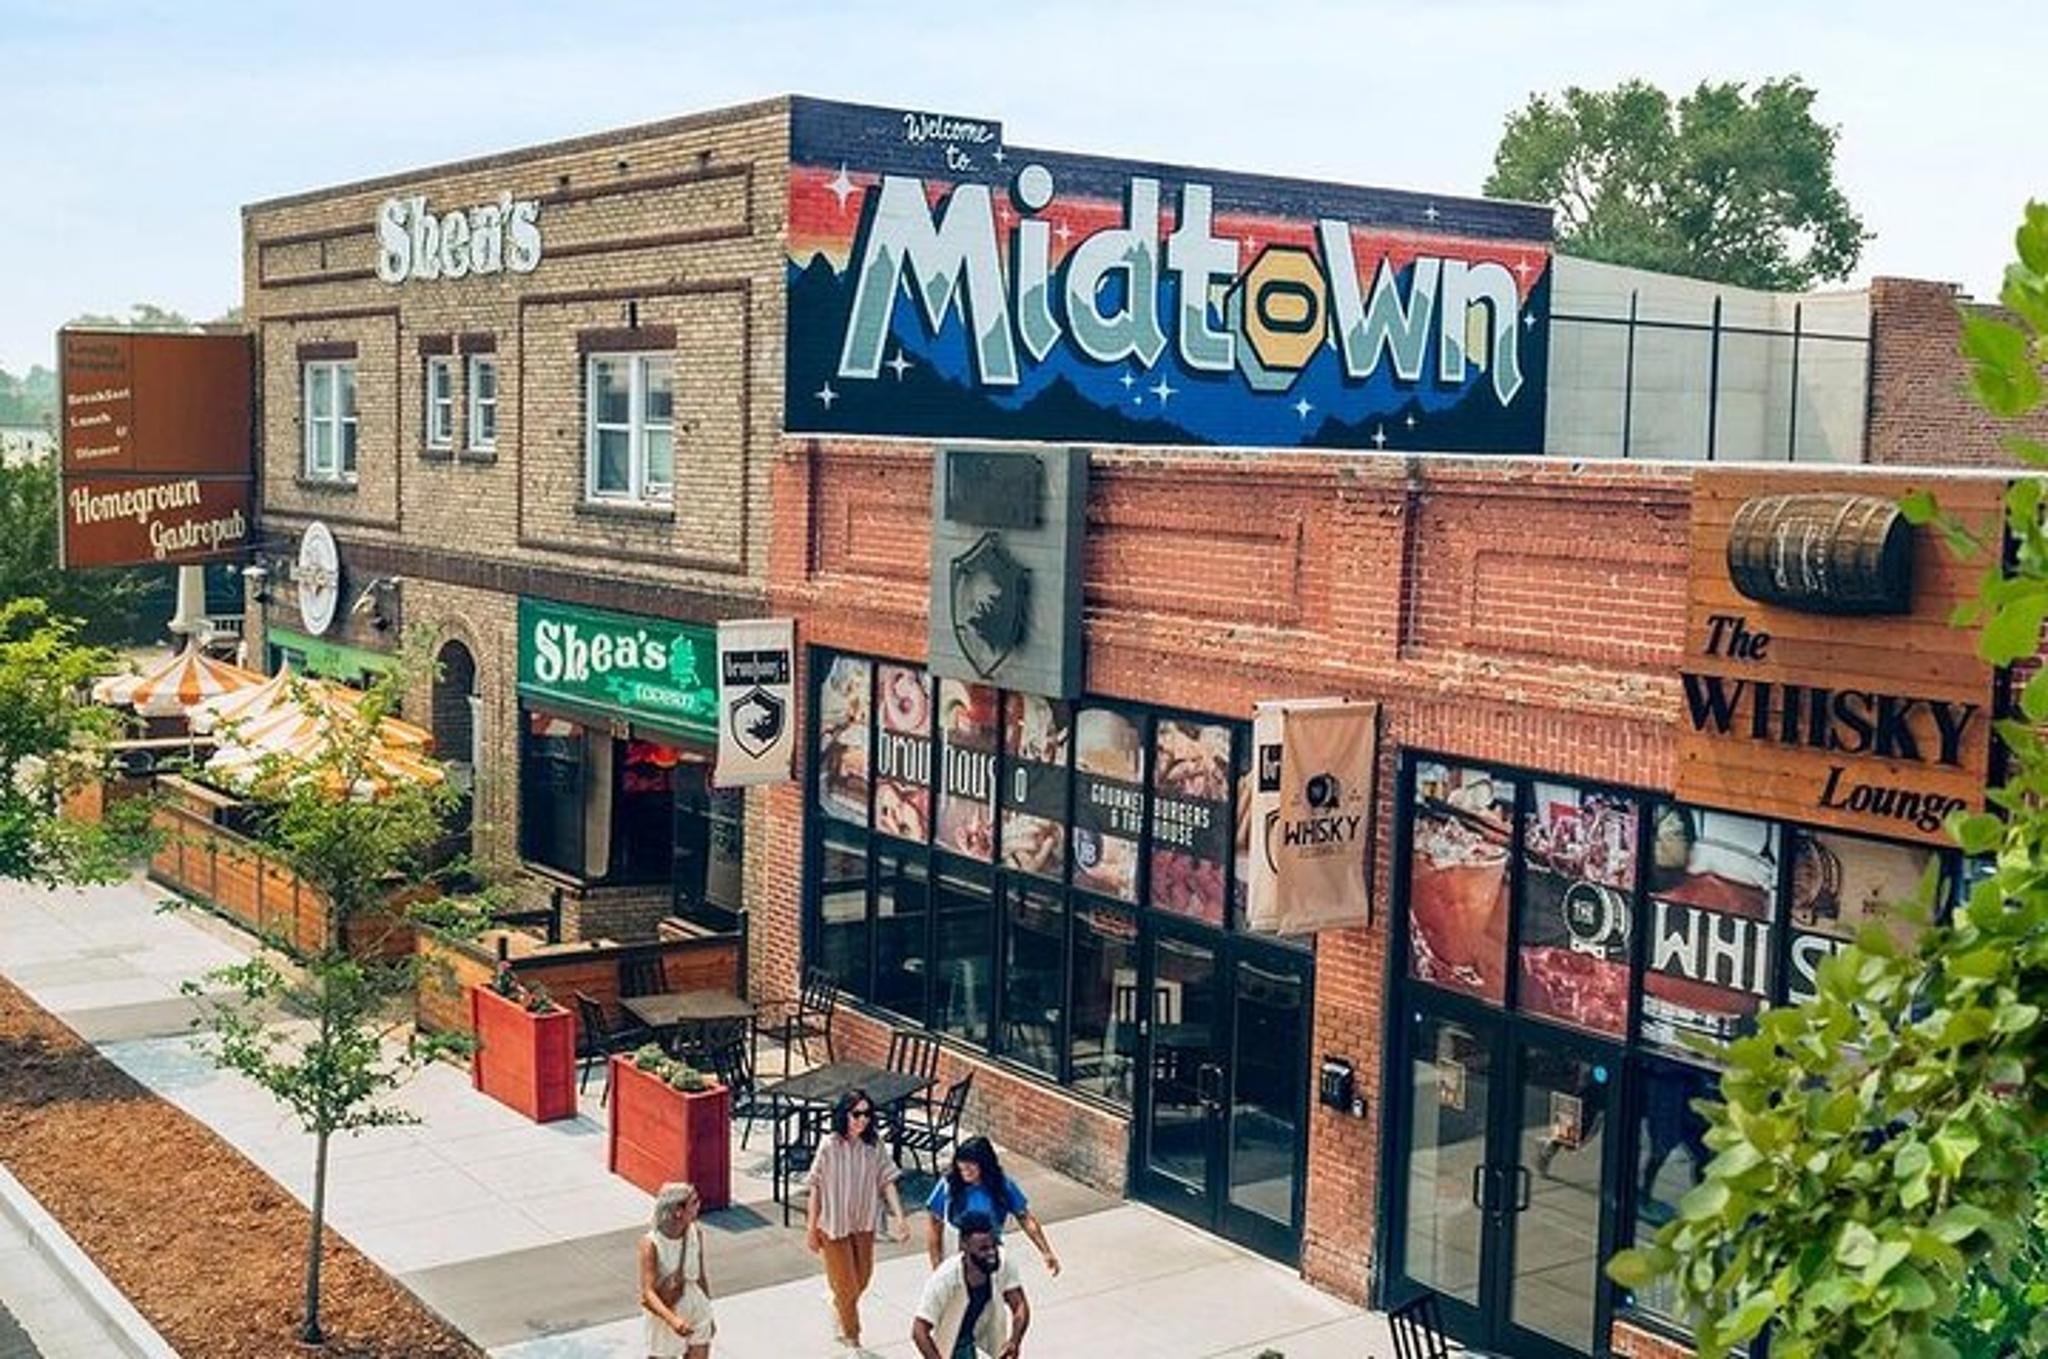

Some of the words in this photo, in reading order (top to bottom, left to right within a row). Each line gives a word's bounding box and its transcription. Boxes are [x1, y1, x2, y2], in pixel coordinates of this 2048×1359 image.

[903, 113, 995, 144] Welcome
[375, 190, 542, 284] Shea's
[837, 164, 1524, 408] Midtown
[69, 412, 112, 428] Lunch
[69, 480, 201, 525] Homegrown
[149, 509, 246, 562] Gastropub
[533, 618, 668, 684] Shea's
[1704, 614, 1771, 660] The
[1679, 672, 1982, 767] WHISKY
